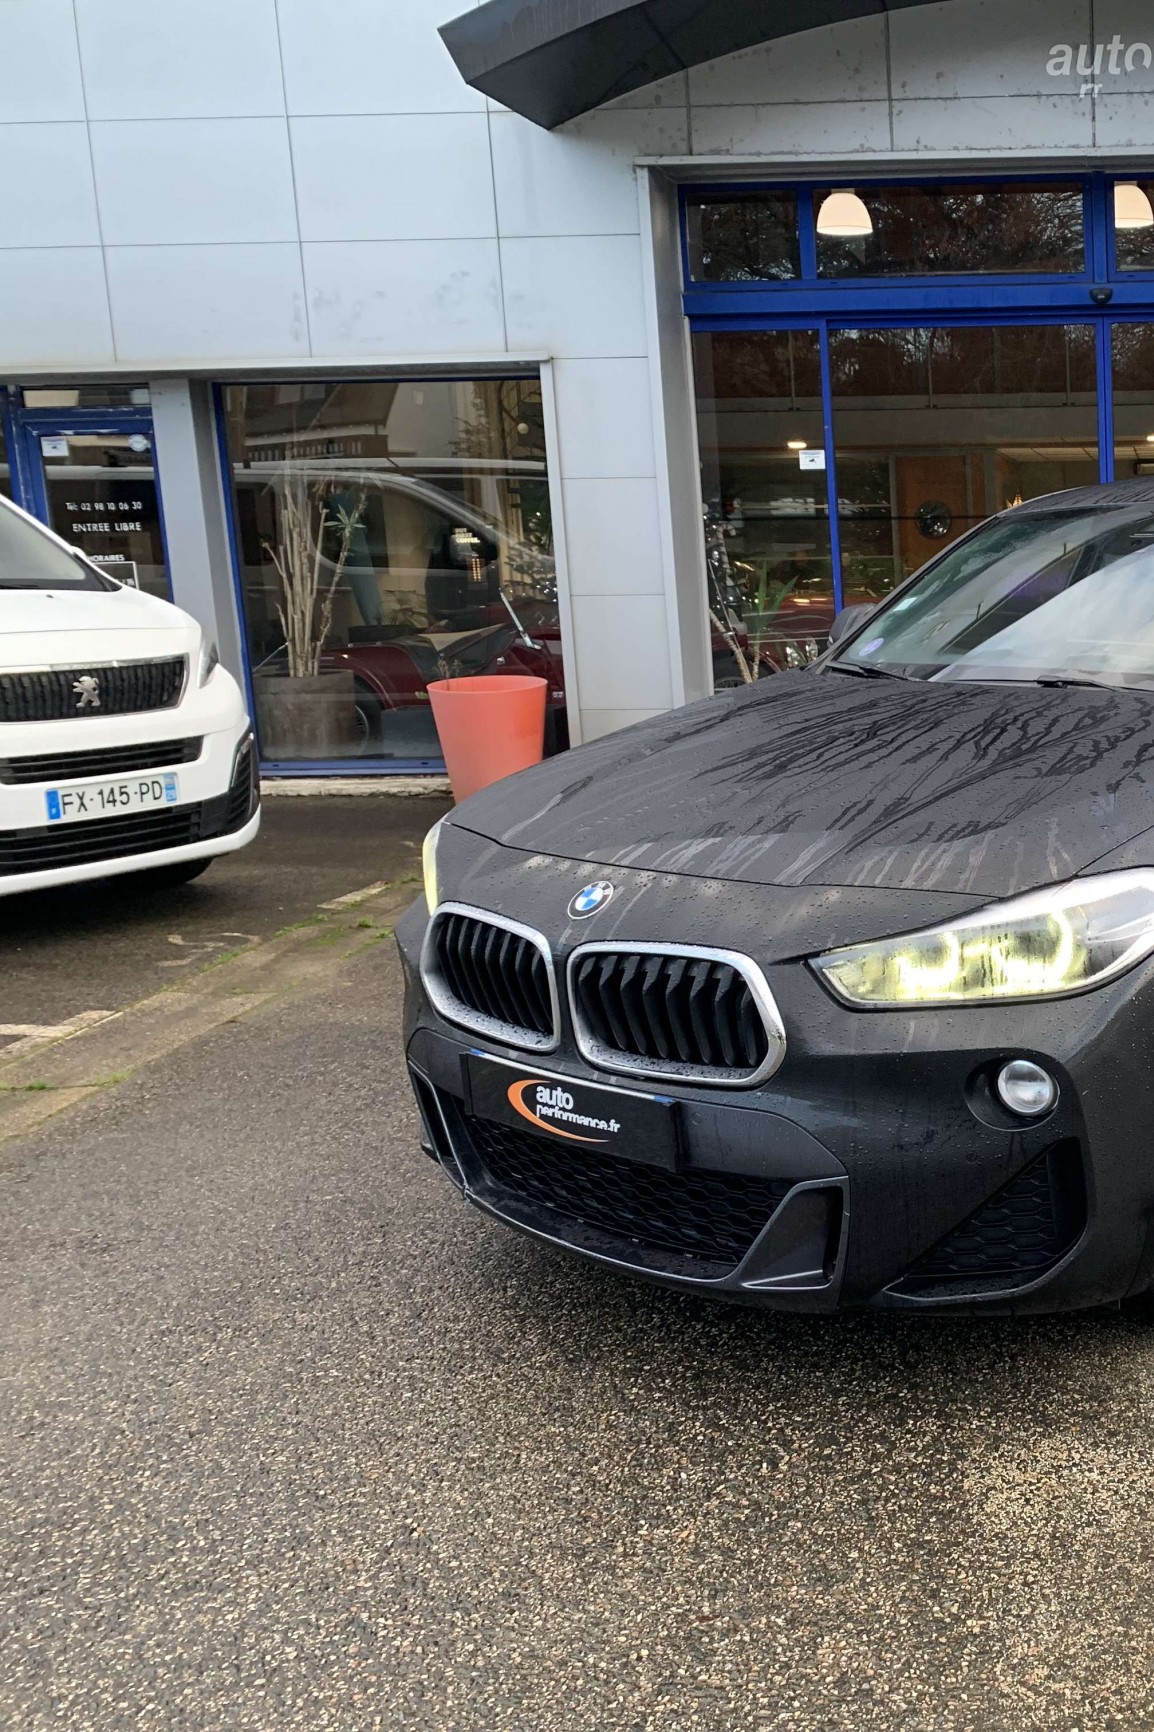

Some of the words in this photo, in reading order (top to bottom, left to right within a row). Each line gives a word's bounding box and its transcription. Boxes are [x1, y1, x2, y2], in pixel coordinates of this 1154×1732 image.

[1046, 34, 1152, 76] auto
[80, 502, 91, 511] 02
[94, 502, 104, 511] 98
[106, 502, 116, 511] 10
[118, 501, 129, 511] 06
[131, 501, 142, 510] 30
[72, 523, 110, 532] ENTREE
[114, 522, 142, 531] LIBRE
[536, 1085, 574, 1110] auto
[536, 1104, 621, 1133] performance.fr
